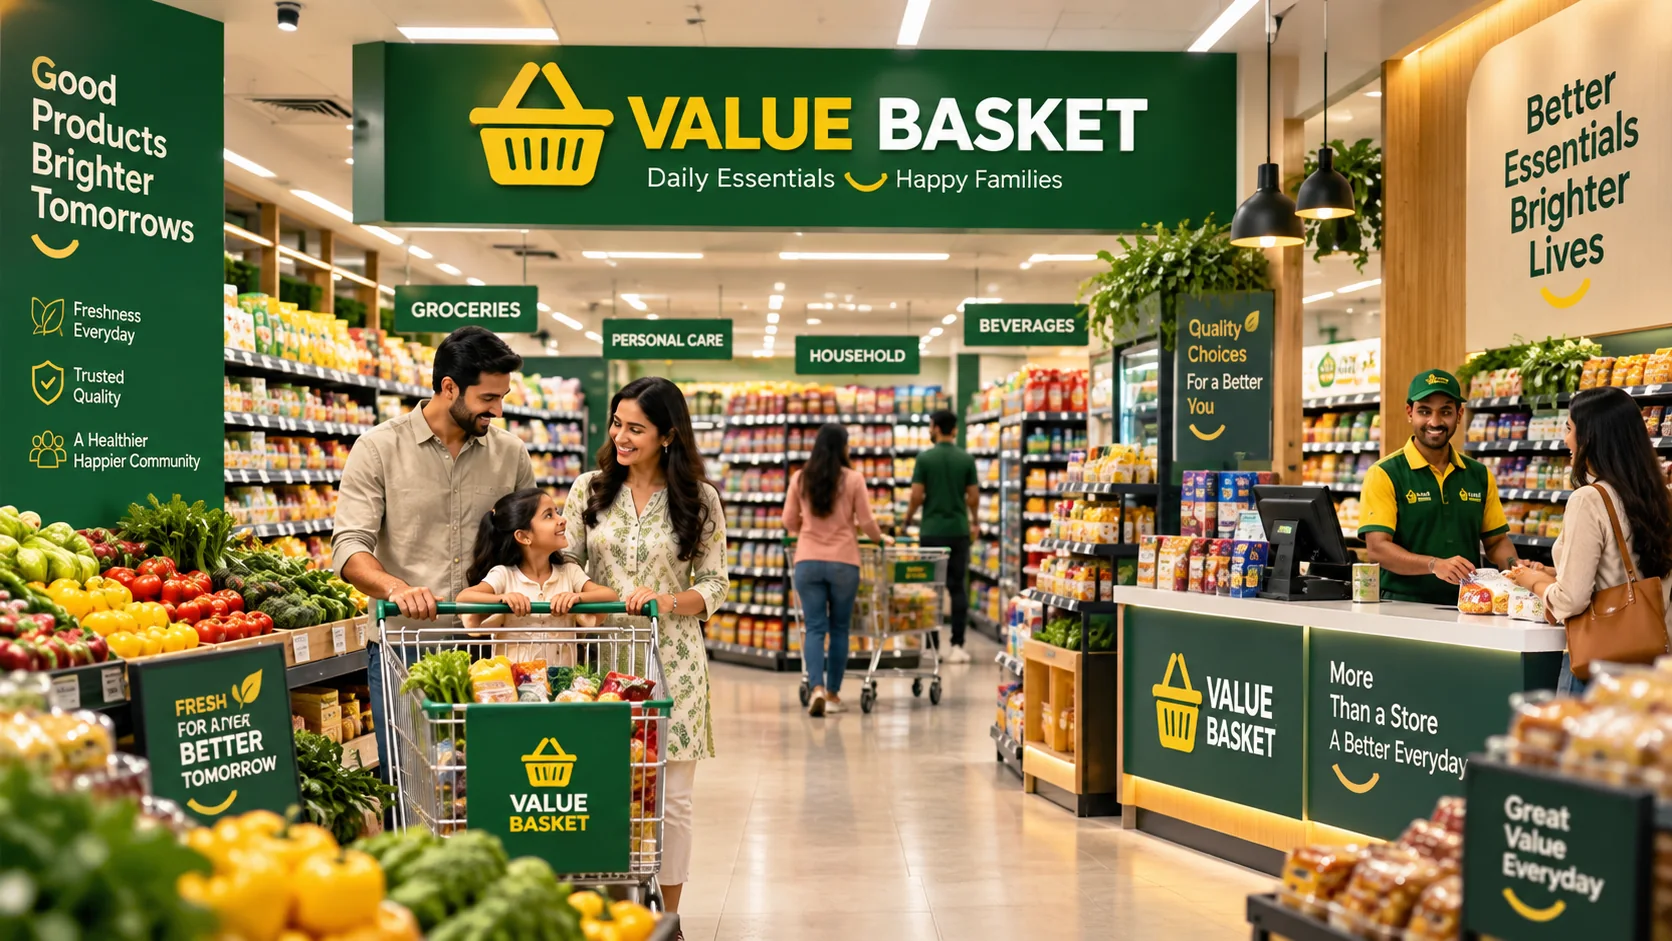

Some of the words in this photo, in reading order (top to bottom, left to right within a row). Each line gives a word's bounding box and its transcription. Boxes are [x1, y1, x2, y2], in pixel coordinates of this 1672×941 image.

[32, 56, 116, 106] Good
[1528, 71, 1616, 134] Better
[33, 98, 166, 158] Products
[628, 97, 852, 150] VALUE
[880, 97, 1148, 151] BASKET
[1505, 110, 1638, 188] Essentials
[33, 142, 154, 195] Brighter
[649, 167, 708, 192] Daily
[719, 168, 834, 187] Essentials
[897, 169, 968, 193] Happy
[976, 170, 1062, 188] Families
[31, 185, 194, 243] Tomorrows
[1512, 171, 1630, 233] Brighter
[1530, 234, 1604, 277] Lives
[74, 301, 141, 322] Freshness
[412, 302, 520, 317] GROCERIES
[74, 323, 135, 345] Everyday
[980, 319, 1074, 332] BEVERAGES
[1189, 319, 1242, 340] Quality
[612, 334, 685, 346] PERSONAL
[687, 334, 723, 346] CARE
[1188, 345, 1246, 362] Choices
[810, 349, 905, 362] HOUSEHOLD
[74, 367, 124, 384] Trusted
[1188, 373, 1208, 389] For
[1211, 378, 1218, 389] a
[1223, 373, 1263, 389] Better
[74, 388, 121, 407] Quality
[1187, 398, 1214, 414] You
[74, 432, 84, 446] A
[89, 433, 148, 447] Healthier
[74, 453, 126, 471] Happier
[130, 454, 200, 471] Community
[1331, 661, 1373, 689] More
[176, 694, 227, 716] FRESH
[1207, 676, 1272, 719] VALUE
[1330, 694, 1370, 722] Than
[1376, 707, 1385, 725] a
[1391, 704, 1438, 734] Store
[178, 719, 207, 737] FOR
[1207, 716, 1276, 757] BASKET
[180, 730, 263, 765] BETTER
[1330, 729, 1340, 750] A
[1345, 732, 1390, 759] Better
[1395, 740, 1468, 780] Everyday
[181, 755, 276, 788] TOMORROW
[510, 794, 587, 812] VALUE
[1505, 795, 1570, 831] Great
[510, 815, 589, 832] BASKET
[1504, 824, 1566, 860] Value
[1503, 852, 1604, 902] Everyday
